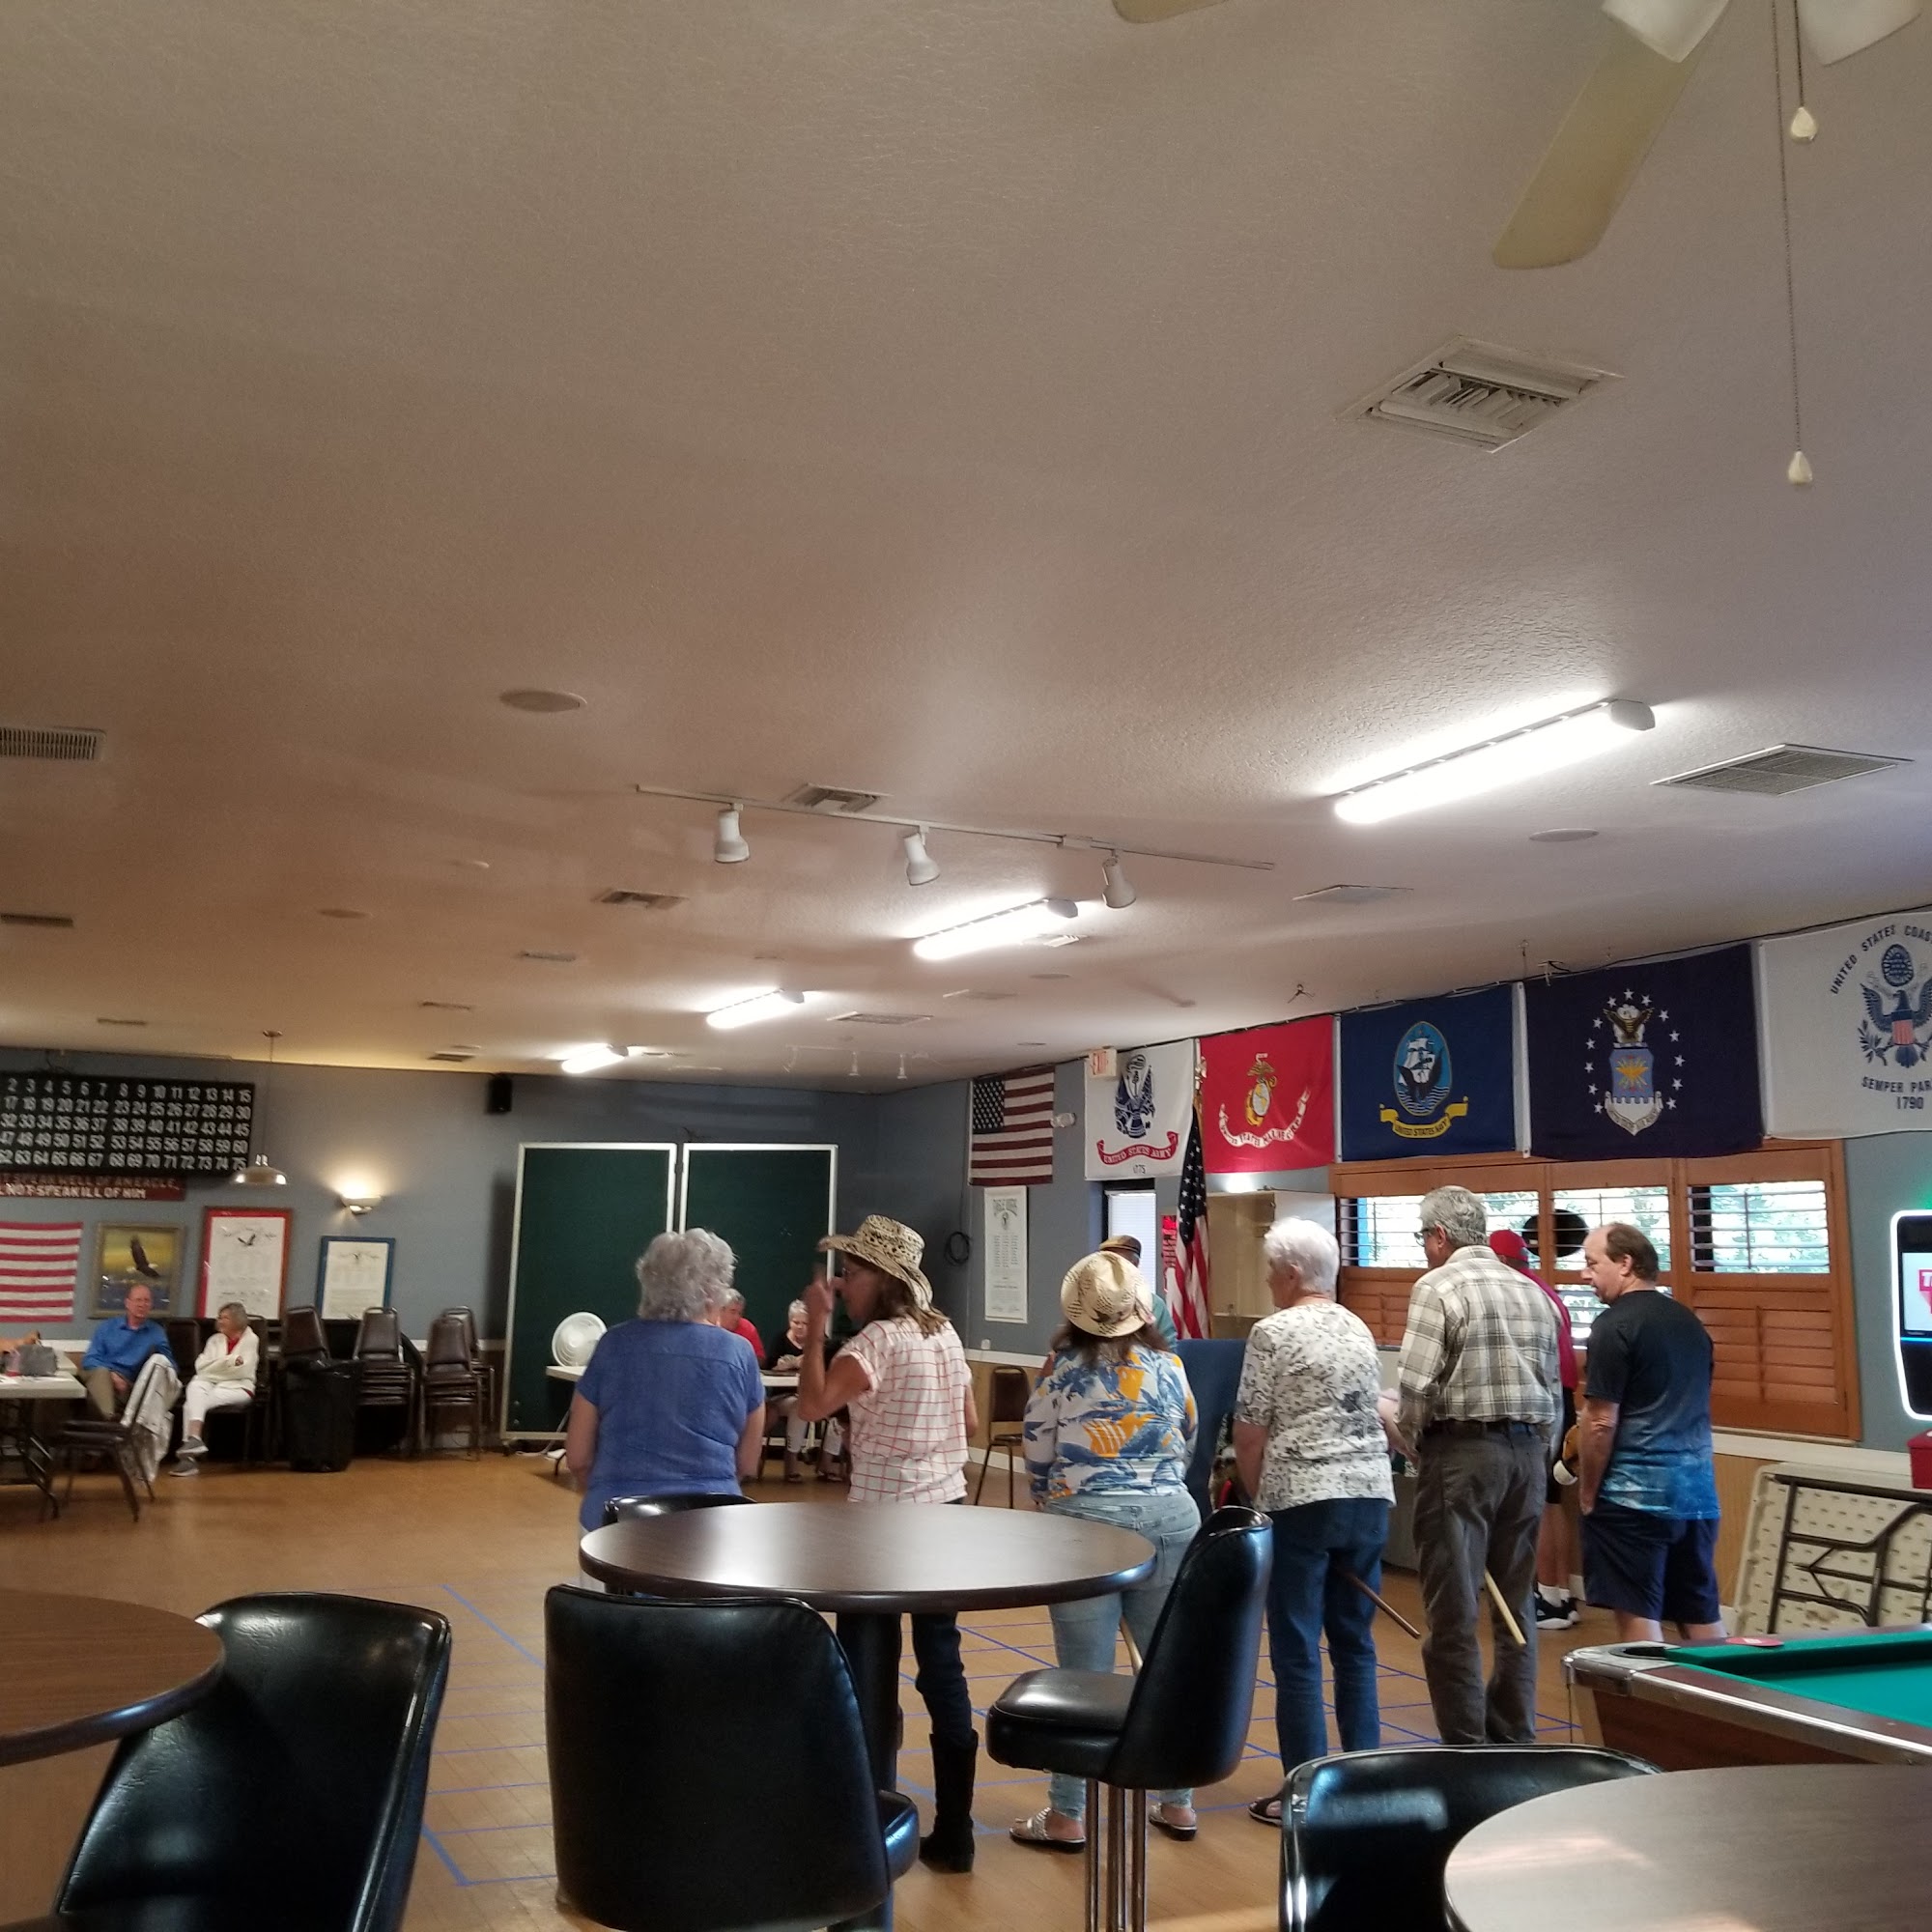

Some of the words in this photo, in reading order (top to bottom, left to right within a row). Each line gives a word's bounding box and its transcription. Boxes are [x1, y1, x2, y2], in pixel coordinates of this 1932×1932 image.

[1831, 954, 1858, 994] UNITED
[1861, 924, 1895, 952] STATES
[1904, 925, 1932, 944] COAS
[8, 1078, 17, 1092] 2
[26, 1079, 36, 1093] 3
[44, 1080, 53, 1094] 4
[62, 1081, 71, 1094] 5
[80, 1082, 90, 1095] 6
[99, 1083, 107, 1096] 7
[119, 1083, 128, 1097] 8
[137, 1084, 146, 1098] 9
[153, 1085, 166, 1098] 10
[171, 1086, 183, 1099] 11
[187, 1087, 200, 1100] 12
[205, 1088, 217, 1101] 13
[222, 1089, 234, 1101] 14
[239, 1090, 251, 1102] 15
[1861, 1076, 1903, 1093] SEMPER
[4, 1095, 18, 1110] 17
[23, 1096, 36, 1111] 18
[42, 1097, 54, 1112] 19
[57, 1098, 73, 1112] 20
[75, 1098, 90, 1113] 21
[93, 1099, 108, 1114] 22
[114, 1100, 129, 1115] 23
[132, 1101, 147, 1115] 24
[150, 1102, 164, 1116] 25
[167, 1102, 183, 1117] 26
[185, 1103, 200, 1117] 27
[202, 1104, 216, 1118] 28
[218, 1105, 234, 1119] 29
[236, 1106, 250, 1120] 30
[1897, 1096, 1923, 1109] 1790
[1, 1113, 17, 1127] 32
[19, 1114, 36, 1128] 33
[37, 1115, 52, 1129] 34
[55, 1116, 71, 1130] 35
[73, 1117, 89, 1131] 36
[91, 1118, 107, 1131] 37
[113, 1118, 128, 1132] 38
[130, 1119, 146, 1132] 39
[148, 1120, 163, 1133] 40
[166, 1121, 181, 1134] 41
[183, 1121, 198, 1135] 42
[201, 1122, 215, 1135] 43
[217, 1122, 232, 1136] 44
[235, 1123, 249, 1137] 45
[1414, 1128, 1435, 1137] STATES
[17, 1132, 34, 1147] 48
[35, 1133, 51, 1147] 49
[53, 1133, 70, 1148] 50
[71, 1134, 86, 1148] 51
[89, 1135, 105, 1149] 52
[111, 1135, 127, 1150] 53
[128, 1136, 143, 1150] 54
[146, 1137, 161, 1151] 55
[164, 1138, 179, 1151] 56
[182, 1138, 196, 1151] 57
[199, 1139, 213, 1152] 58
[215, 1140, 230, 1152] 59
[233, 1140, 247, 1153] 60
[14, 1151, 31, 1165] 63
[33, 1151, 48, 1165] 64
[51, 1151, 68, 1166] 65
[70, 1152, 85, 1166] 66
[88, 1152, 103, 1167] 67
[109, 1152, 125, 1167] 68
[128, 1153, 142, 1167] 69
[146, 1154, 160, 1168] 70
[163, 1155, 177, 1168] 71
[181, 1155, 194, 1169] 72
[198, 1156, 212, 1170] 73
[215, 1157, 228, 1170] 74
[1103, 1151, 1127, 1164] UNITED
[1127, 1146, 1151, 1156] STATES
[1150, 1148, 1172, 1158] ARMY
[36, 1185, 79, 1197] SPEAK
[103, 1187, 121, 1198] OF
[122, 1188, 146, 1199] HIM
